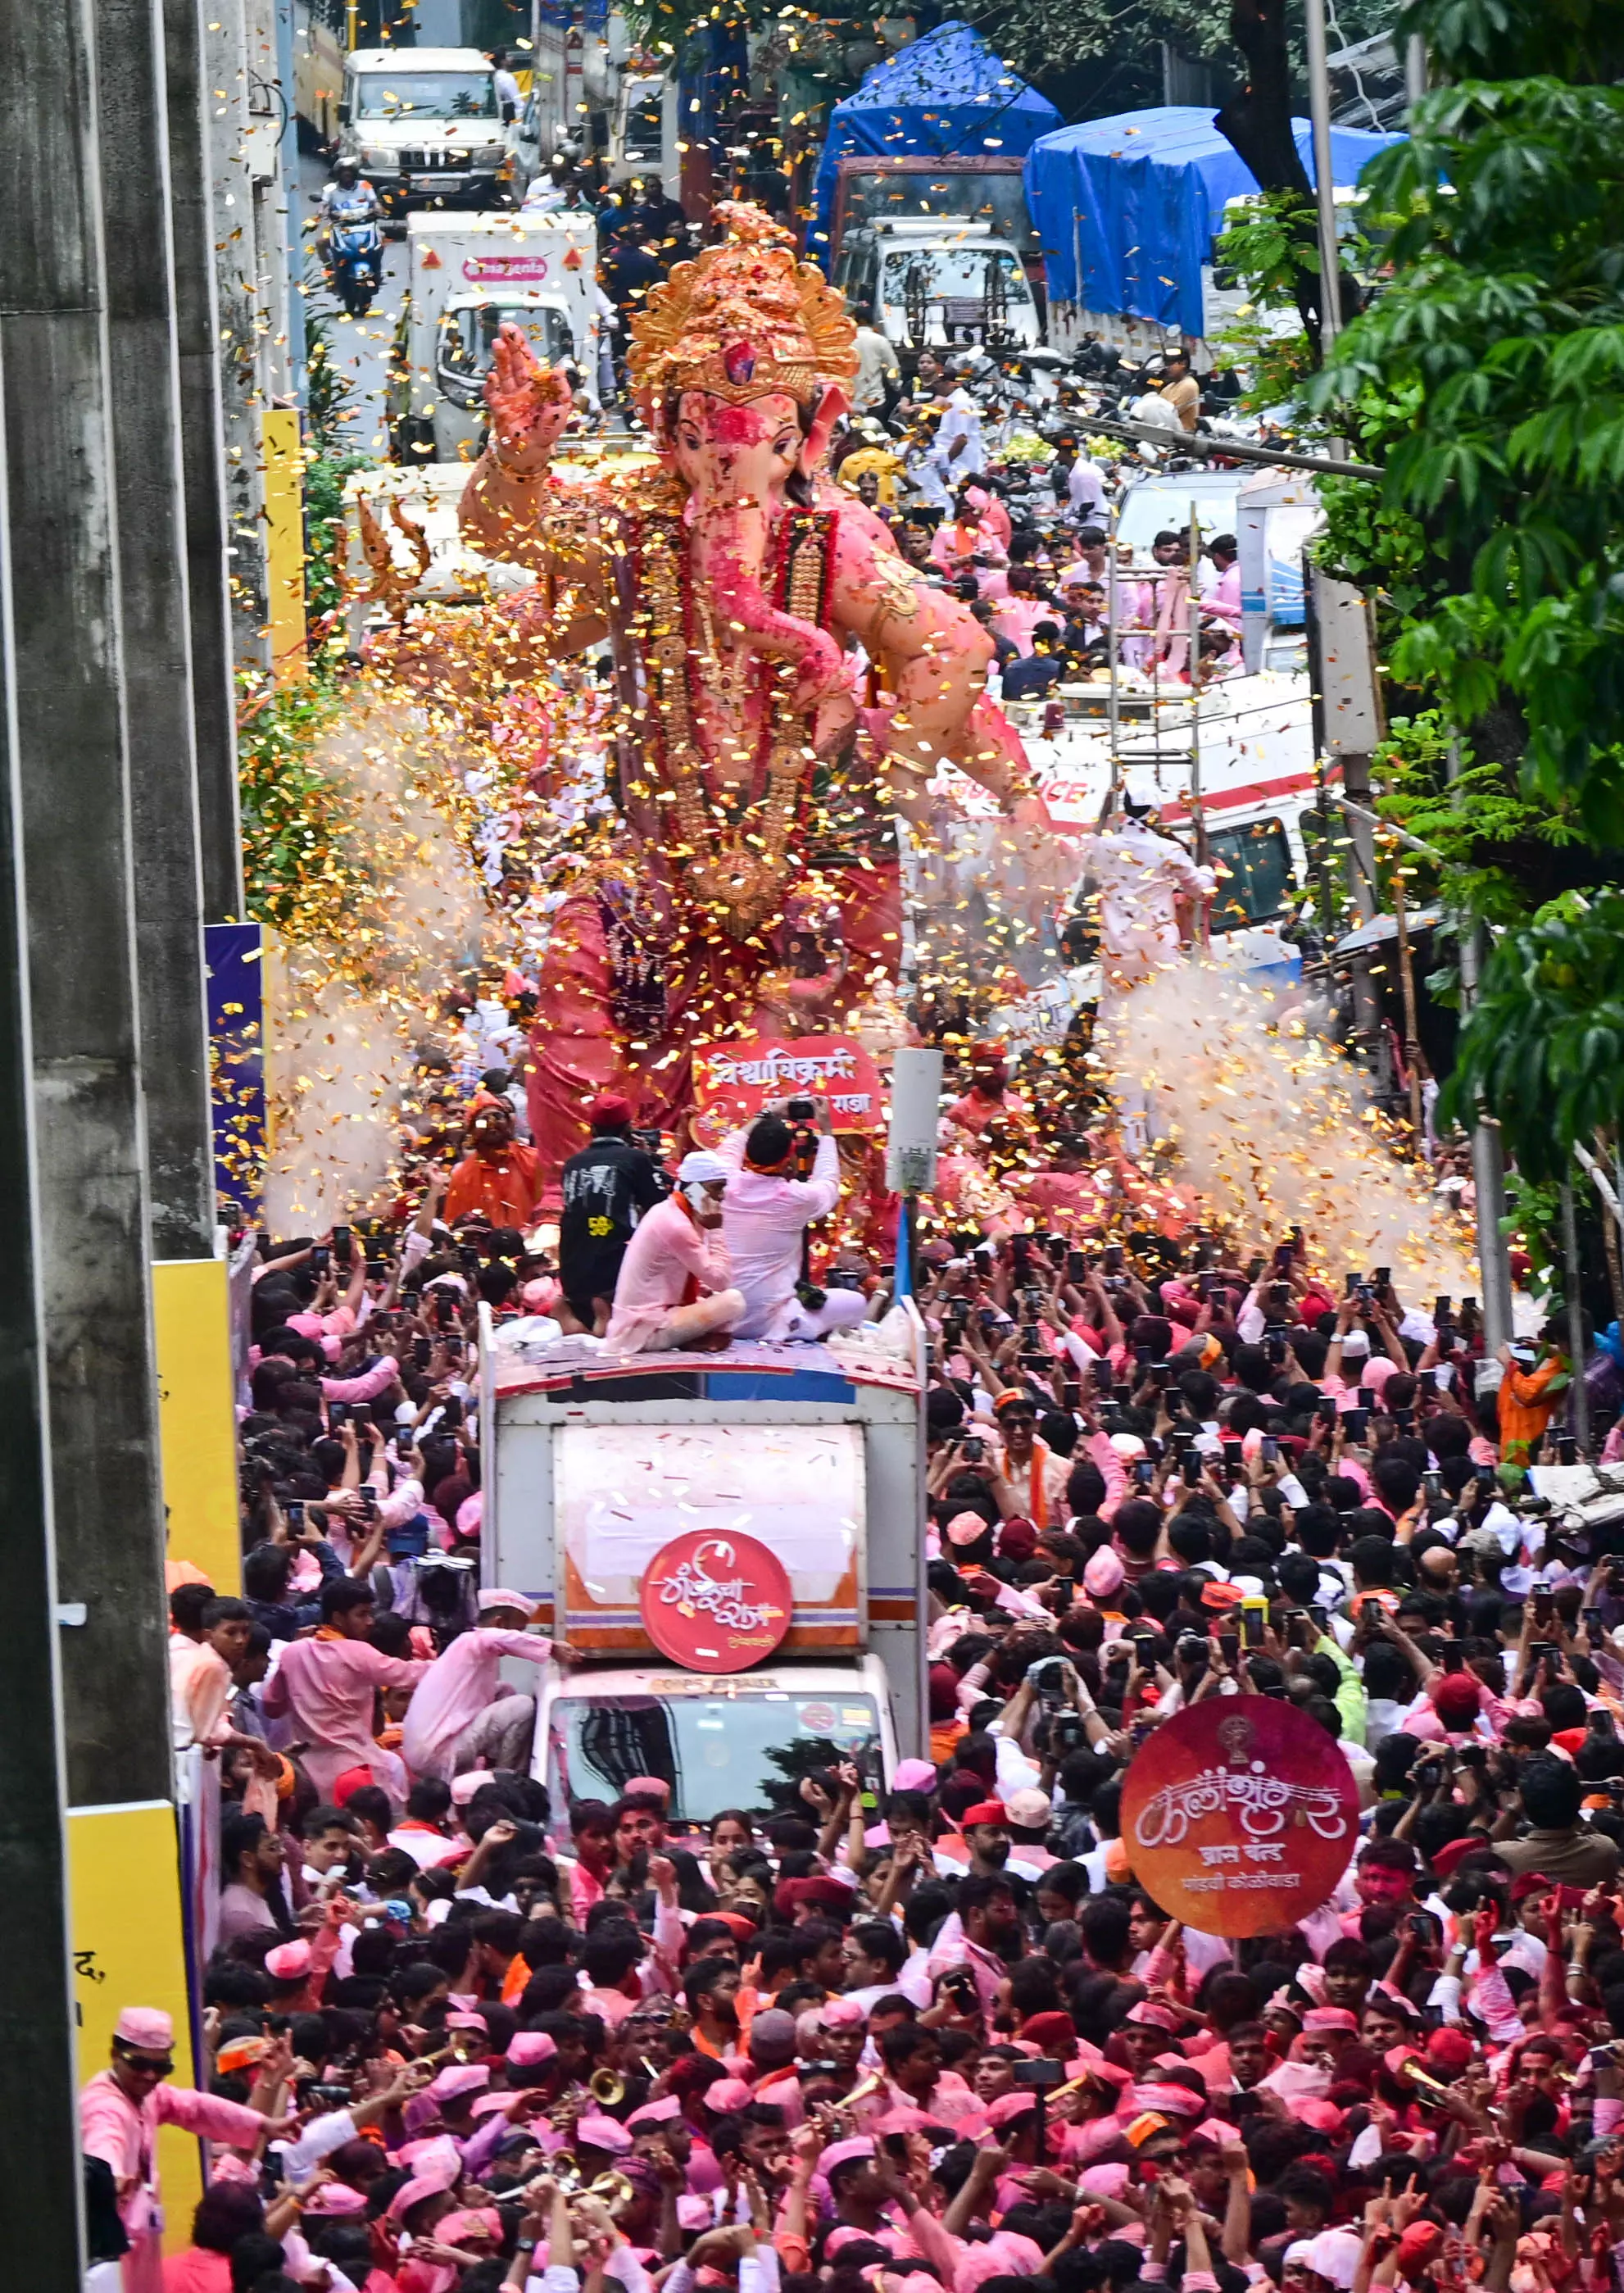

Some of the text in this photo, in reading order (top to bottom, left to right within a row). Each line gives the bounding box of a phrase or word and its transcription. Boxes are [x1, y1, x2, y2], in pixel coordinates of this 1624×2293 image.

[829, 1093, 873, 1114] राजा
[1199, 1846, 1240, 1867] ब्रास
[1226, 1870, 1301, 1889] कोळीवाडा
